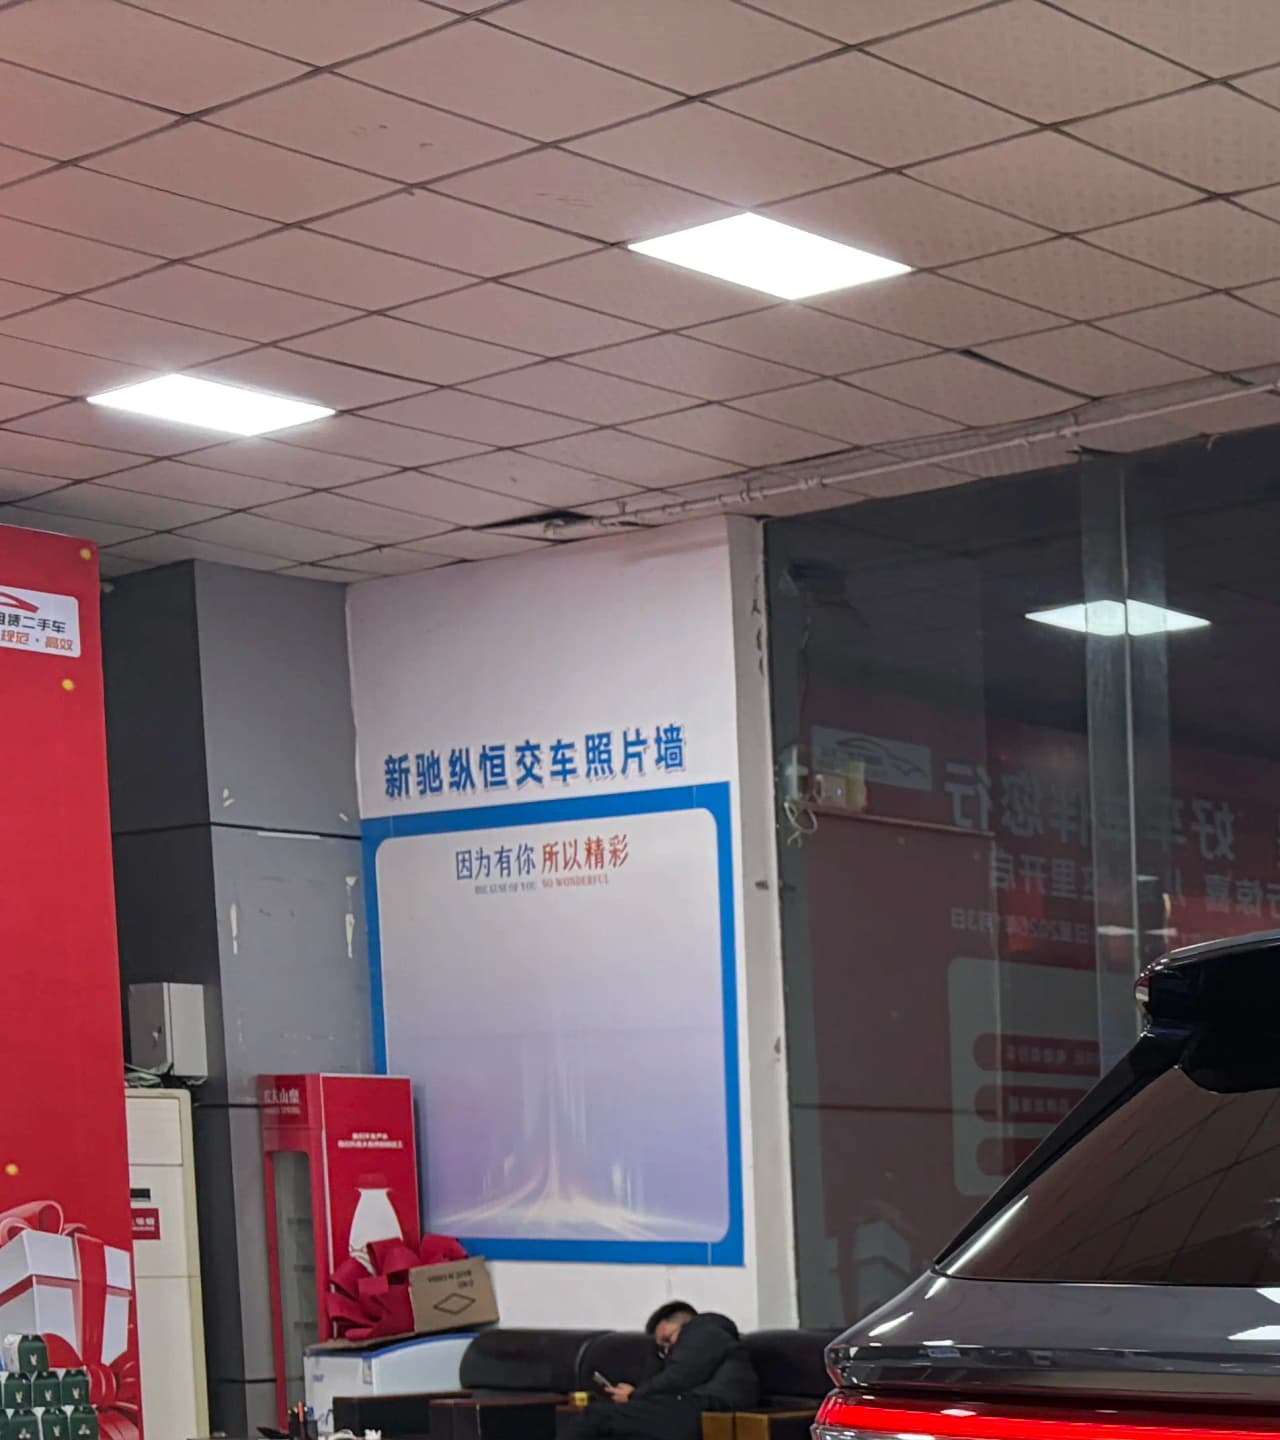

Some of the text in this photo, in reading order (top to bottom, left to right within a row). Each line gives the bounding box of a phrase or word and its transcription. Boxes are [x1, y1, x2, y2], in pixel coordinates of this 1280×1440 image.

[384, 723, 684, 799] 新驰纵恒交车照片墙
[456, 834, 629, 880] 因为有你 所以精彩
